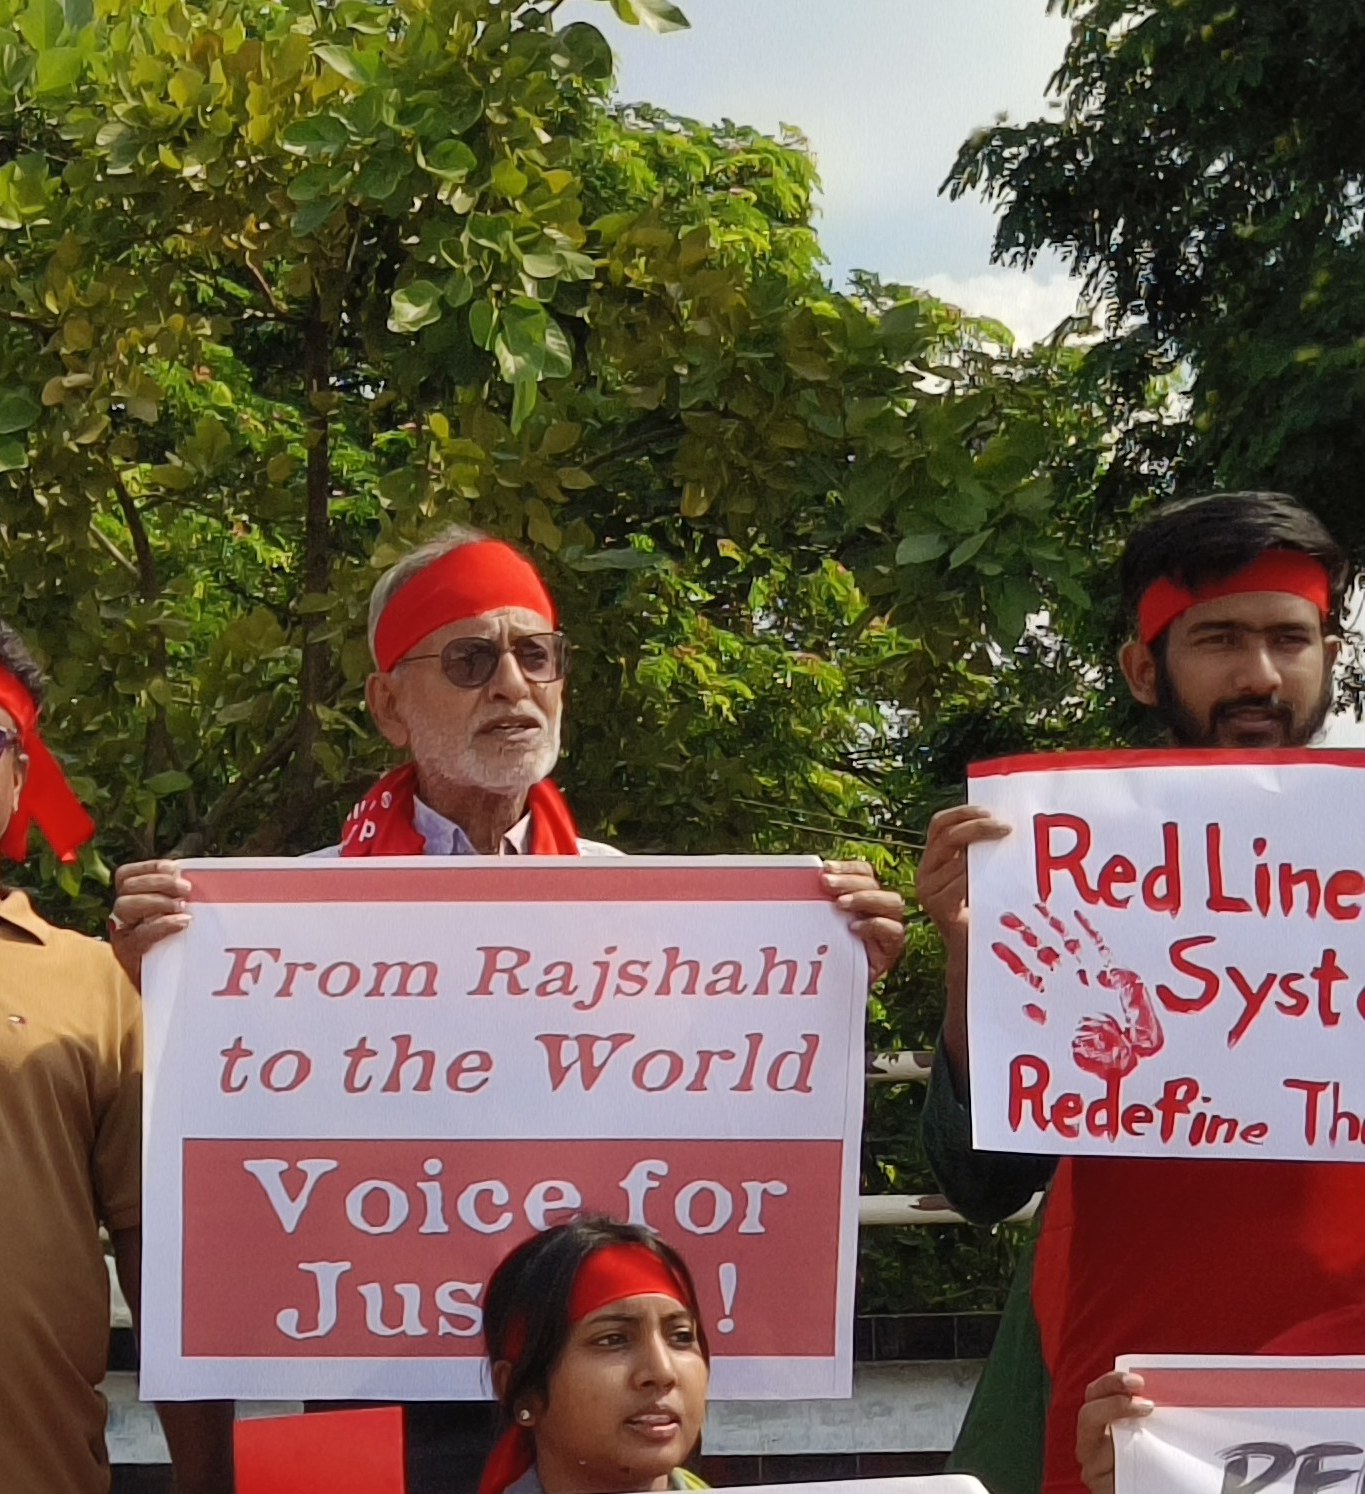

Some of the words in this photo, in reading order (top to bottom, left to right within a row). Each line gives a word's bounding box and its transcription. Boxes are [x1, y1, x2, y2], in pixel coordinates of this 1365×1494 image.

[1033, 813, 1181, 919] Red
[210, 946, 439, 998] From
[466, 944, 829, 1010] Rajshahi
[1155, 935, 1365, 1049] Syst
[218, 1036, 312, 1094] to
[342, 1034, 494, 1093] the
[534, 1033, 821, 1093] World
[1008, 1053, 1269, 1147] Redefine
[1282, 1079, 1365, 1148] Th
[242, 1158, 582, 1235] Voice
[618, 1160, 788, 1235] for
[275, 1261, 736, 1340] Jus!
